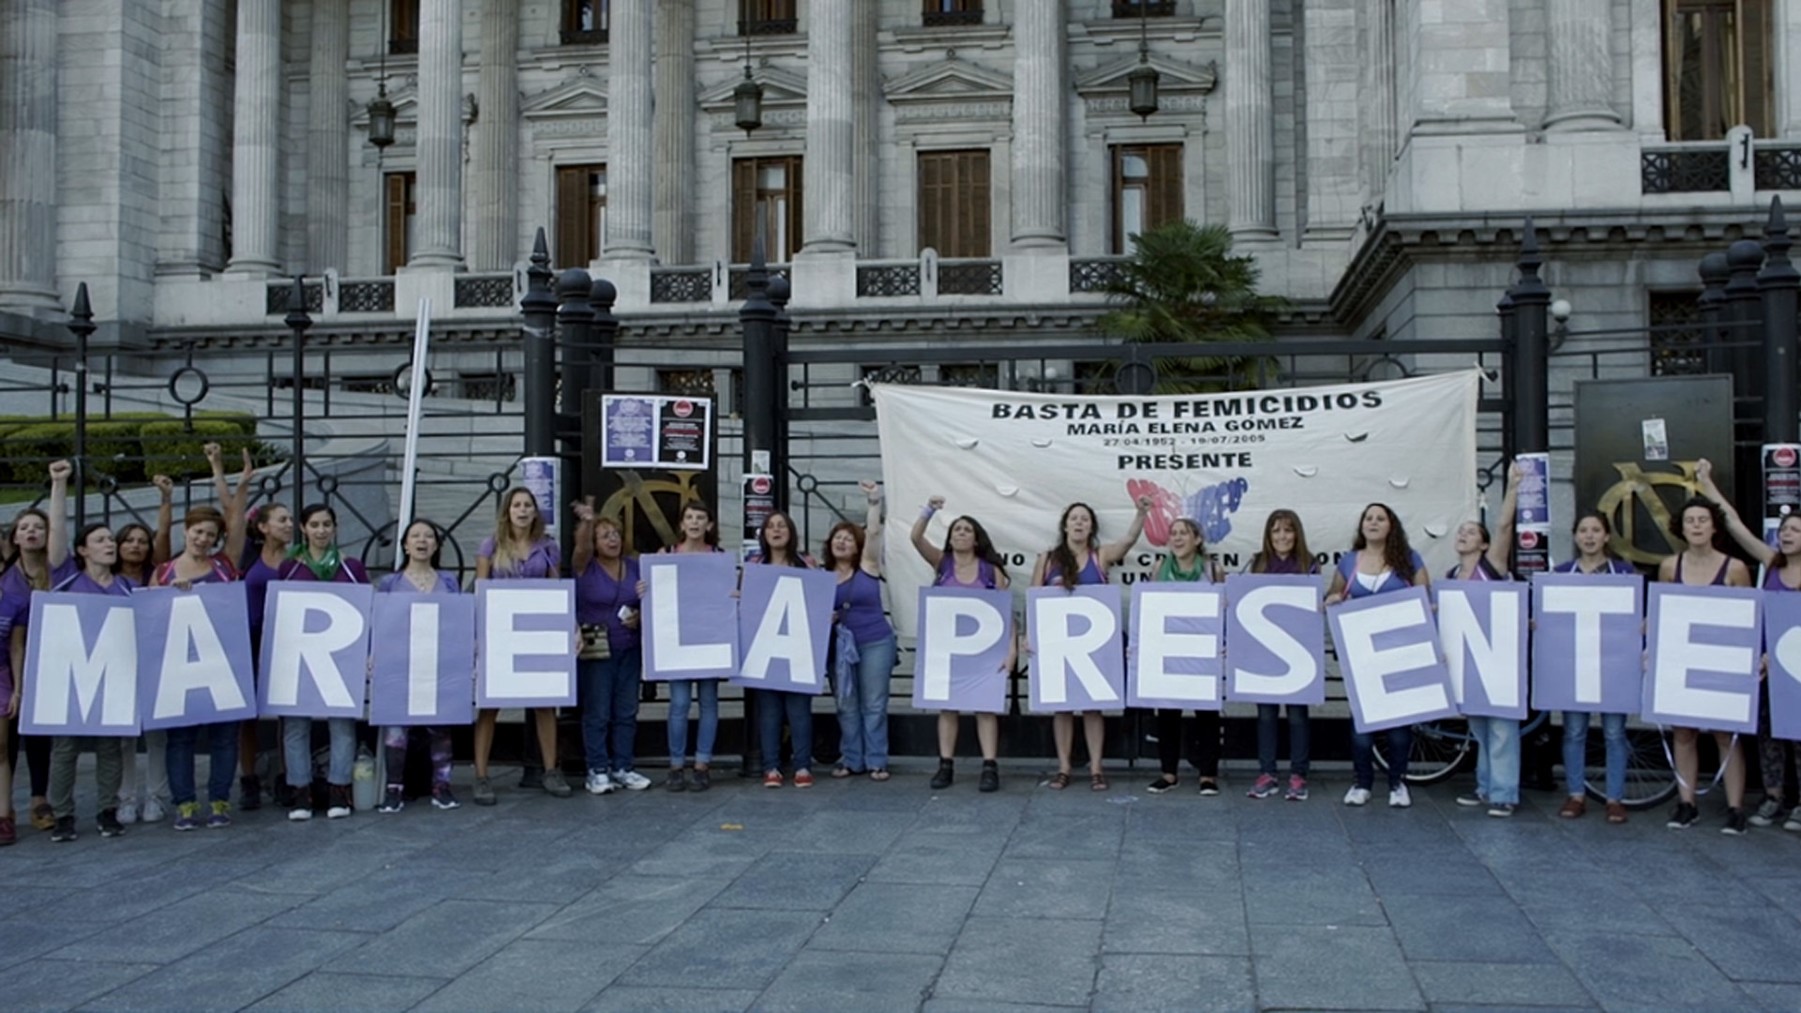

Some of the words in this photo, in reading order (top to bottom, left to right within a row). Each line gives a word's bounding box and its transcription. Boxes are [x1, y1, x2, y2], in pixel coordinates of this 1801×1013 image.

[991, 403, 1101, 420] BASTA
[1117, 402, 1158, 419] DE
[1173, 391, 1382, 419] FEMICIDIOS
[1066, 420, 1140, 436] MARÍA
[1148, 420, 1216, 434] ELENA
[1225, 415, 1304, 432] GÓMEZ
[1118, 452, 1252, 470] PRESENTE
[924, 586, 1756, 724] PRESENTE
